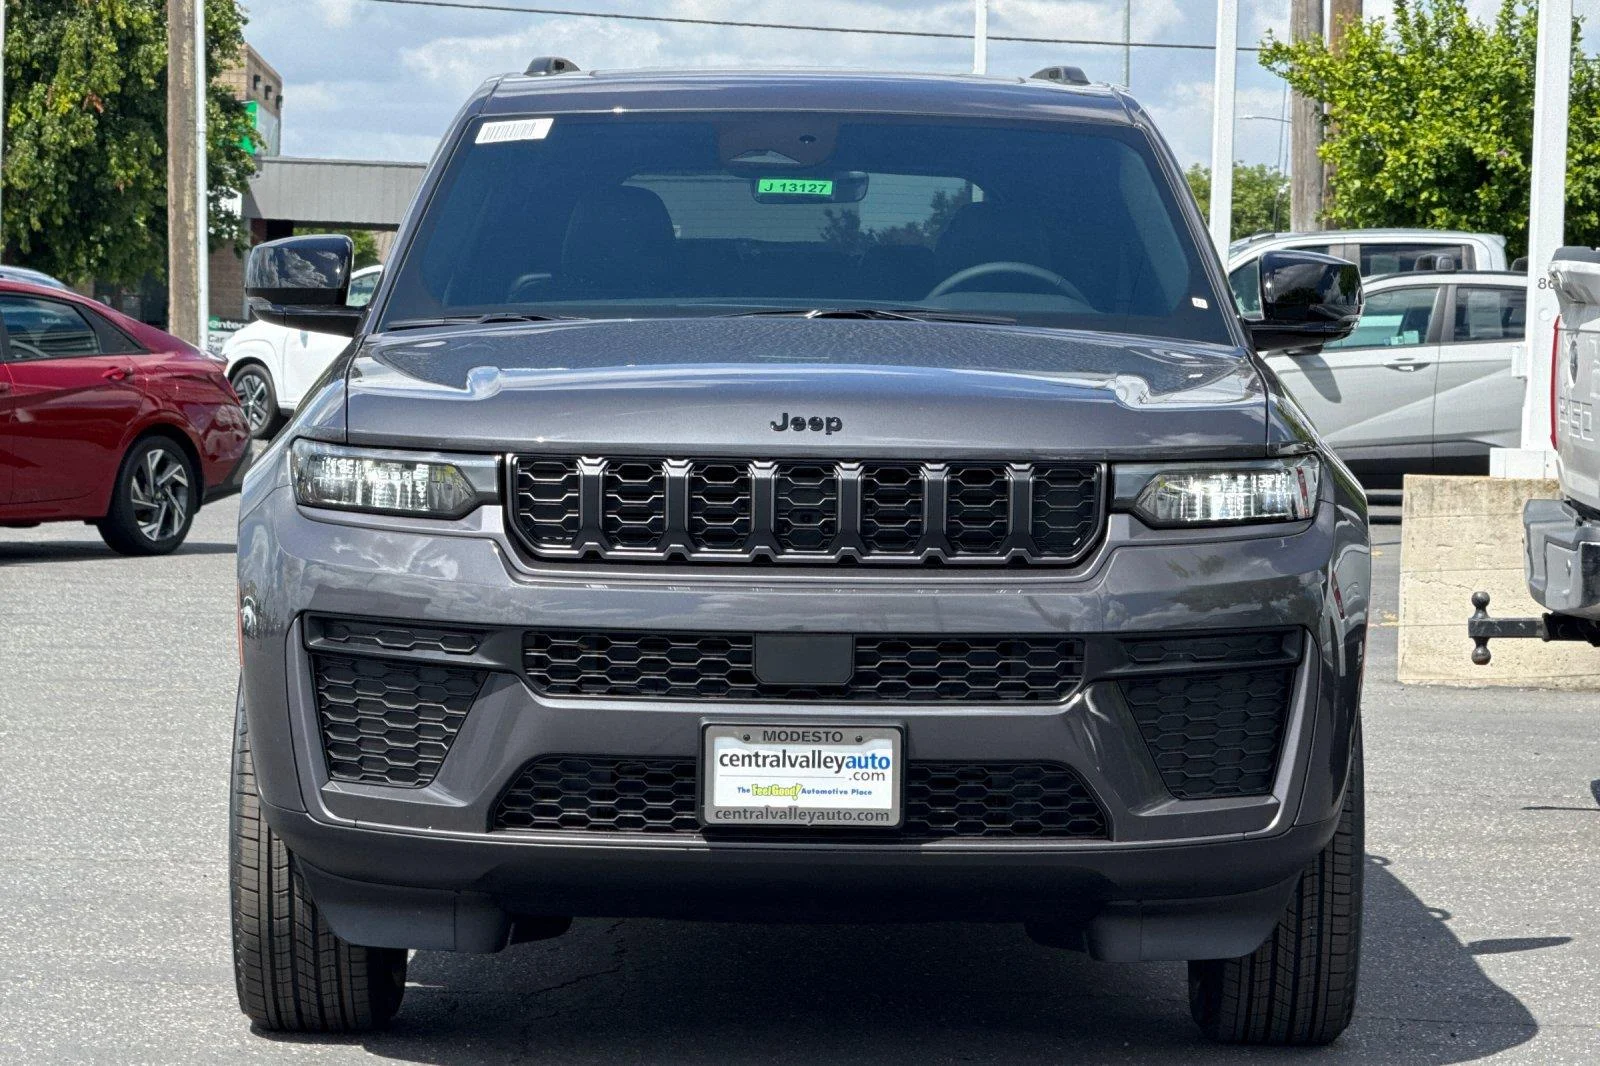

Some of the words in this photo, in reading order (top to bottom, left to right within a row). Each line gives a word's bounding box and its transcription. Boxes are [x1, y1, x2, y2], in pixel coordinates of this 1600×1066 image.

[764, 183, 774, 192] J
[780, 183, 827, 193] 13127
[770, 412, 843, 436] Jeep
[762, 730, 844, 743] MODESTO
[719, 748, 891, 774] centralvalleyauto
[848, 770, 886, 782] .com
[737, 786, 751, 794] The
[801, 787, 849, 796] Automotive
[851, 788, 873, 796] Place
[715, 805, 890, 823] centralvalleyauto.com
